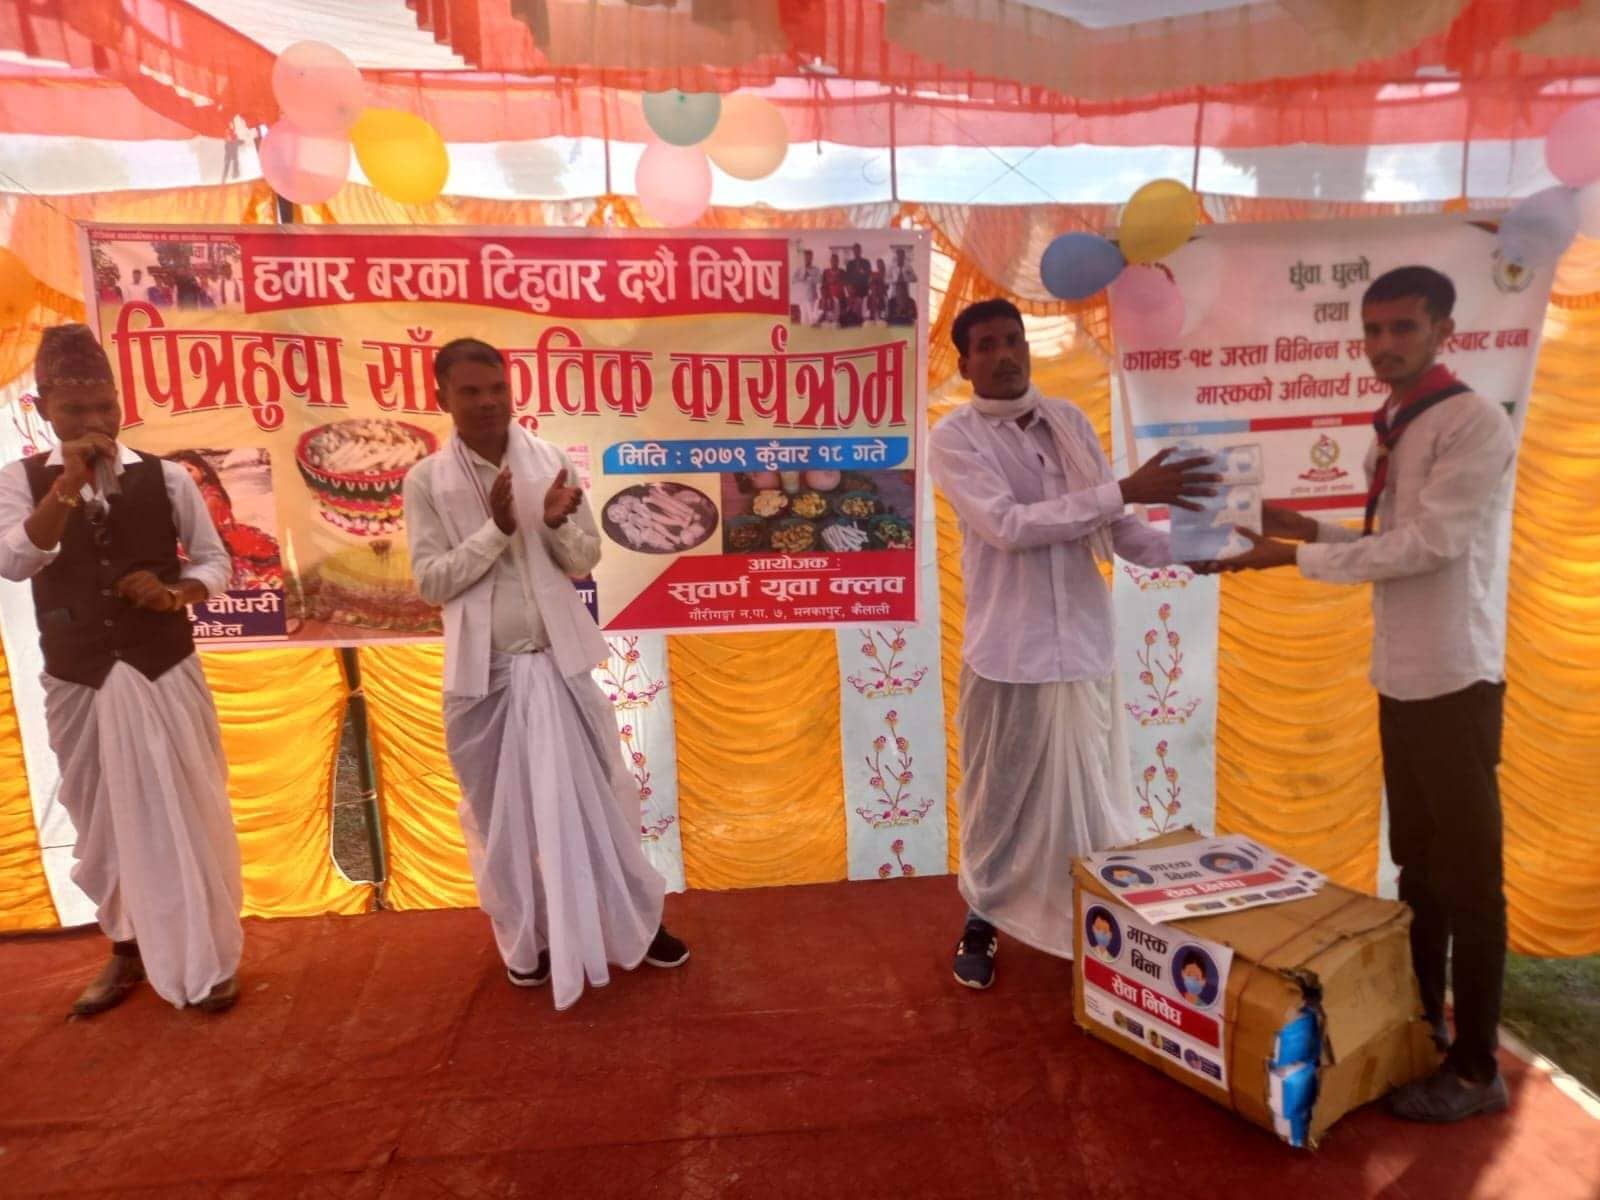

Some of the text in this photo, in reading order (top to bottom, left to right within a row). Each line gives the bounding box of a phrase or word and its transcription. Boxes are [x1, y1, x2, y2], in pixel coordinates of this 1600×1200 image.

[252, 256, 355, 302] हमार
[366, 257, 469, 302] बरका
[481, 243, 605, 312] टिहुवार
[690, 244, 783, 303] विशेष
[1313, 301, 1351, 323] तथा
[1220, 344, 1269, 367] जस्ता
[362, 325, 653, 431] साँकृतिक
[619, 442, 666, 467] मिति
[690, 447, 746, 468] २०७९
[853, 440, 887, 462] गते
[668, 576, 750, 605] सुवर्ण
[761, 577, 820, 602] यूवा
[1127, 925, 1169, 955] मास्क
[1131, 949, 1163, 980] बिना
